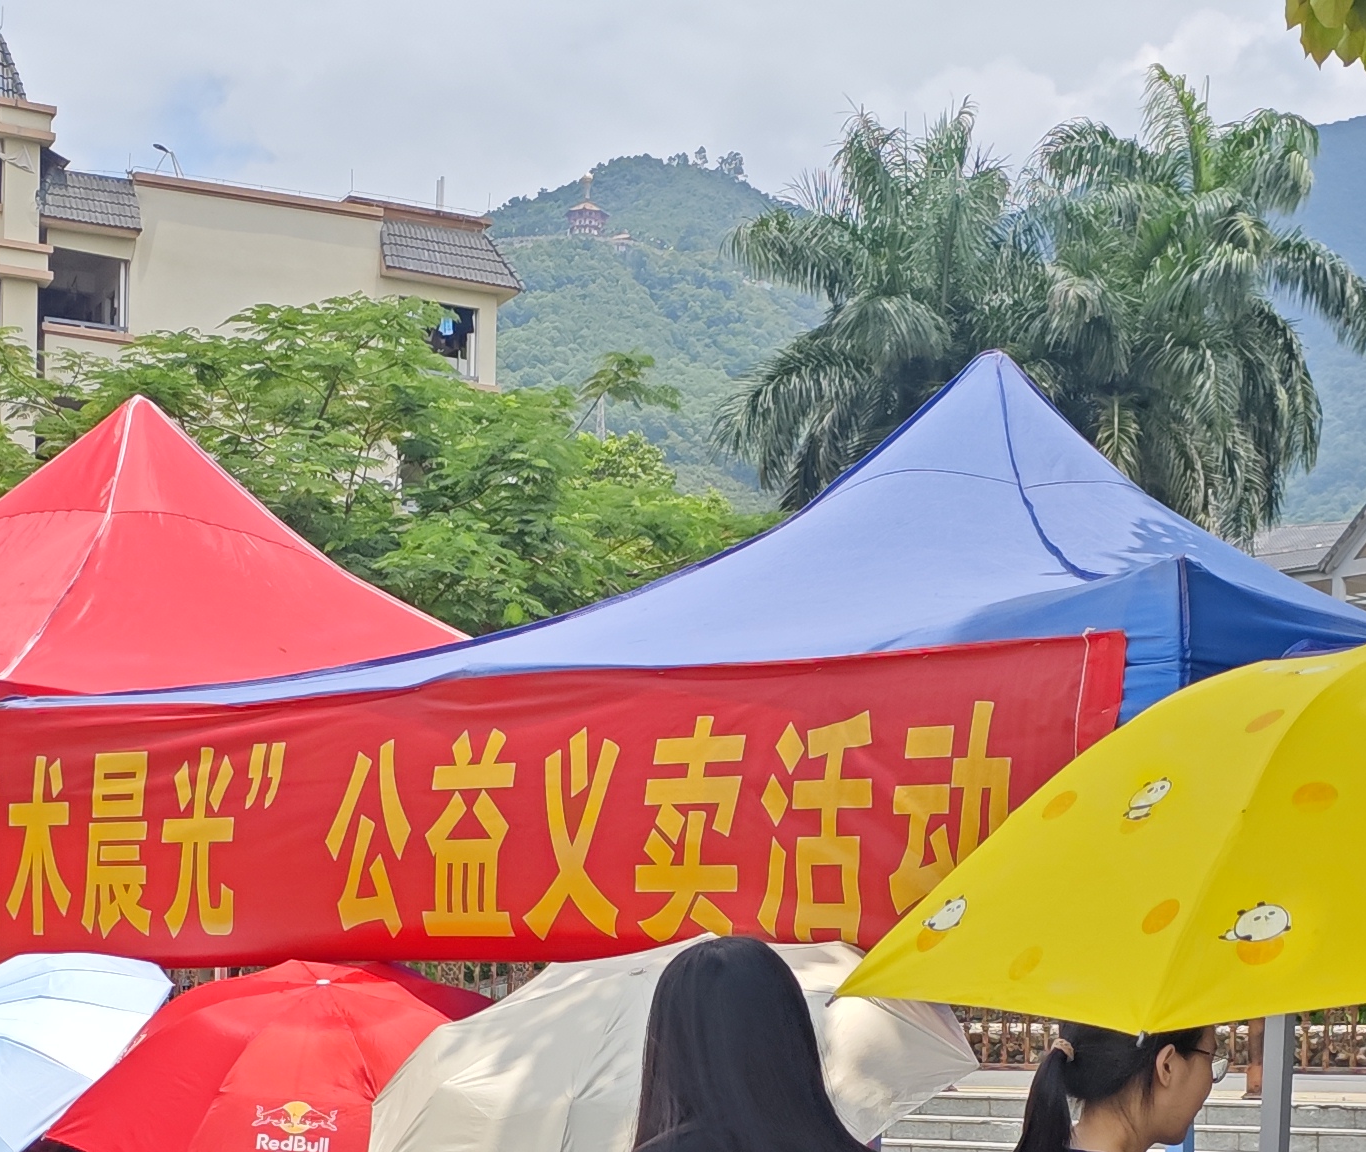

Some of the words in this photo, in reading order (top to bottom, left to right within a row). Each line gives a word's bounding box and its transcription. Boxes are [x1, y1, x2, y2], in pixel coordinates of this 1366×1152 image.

[325, 700, 1012, 944] 公益义卖活动
